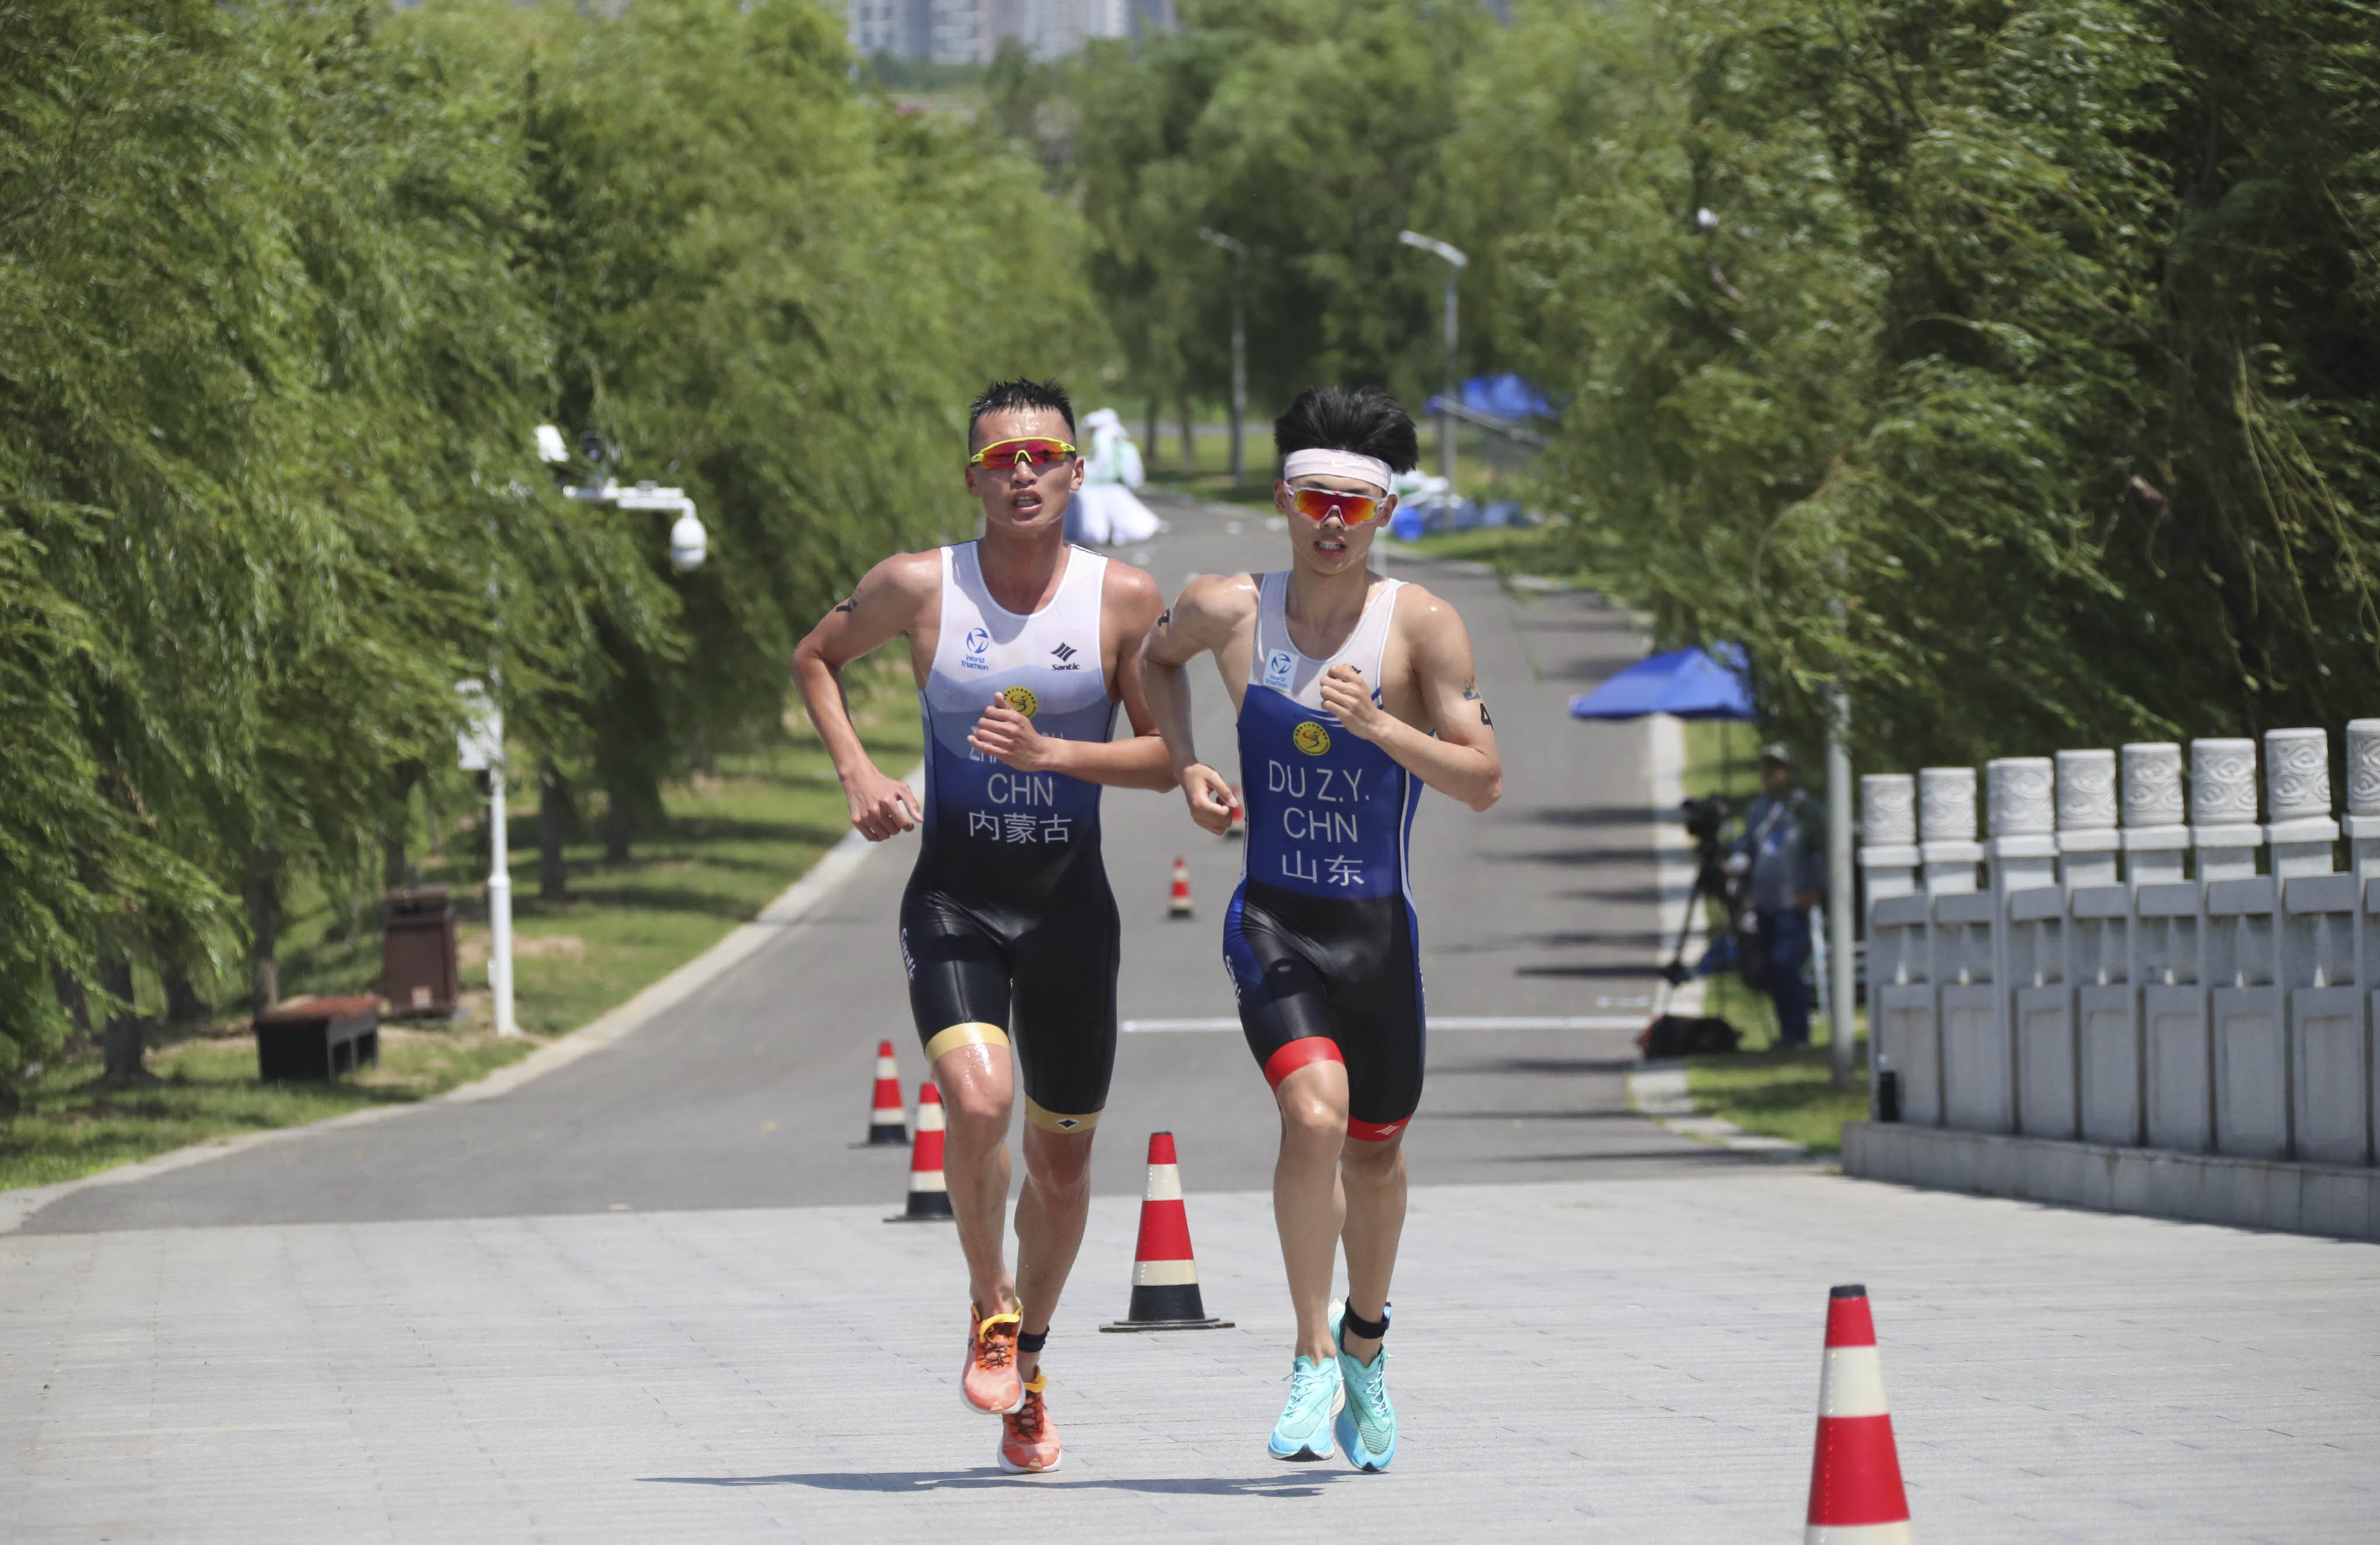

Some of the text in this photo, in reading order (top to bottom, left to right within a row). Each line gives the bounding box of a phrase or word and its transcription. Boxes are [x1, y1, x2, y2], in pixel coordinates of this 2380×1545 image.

[961, 659, 989, 670] Triathlon
[965, 654, 985, 663] World
[1052, 662, 1080, 671] Santic
[988, 773, 1053, 807] CHN
[1268, 759, 1370, 802] DU Z.Y.
[968, 810, 1072, 845] 内蒙古
[1283, 807, 1358, 844] CHN
[1281, 850, 1365, 887] 山东
